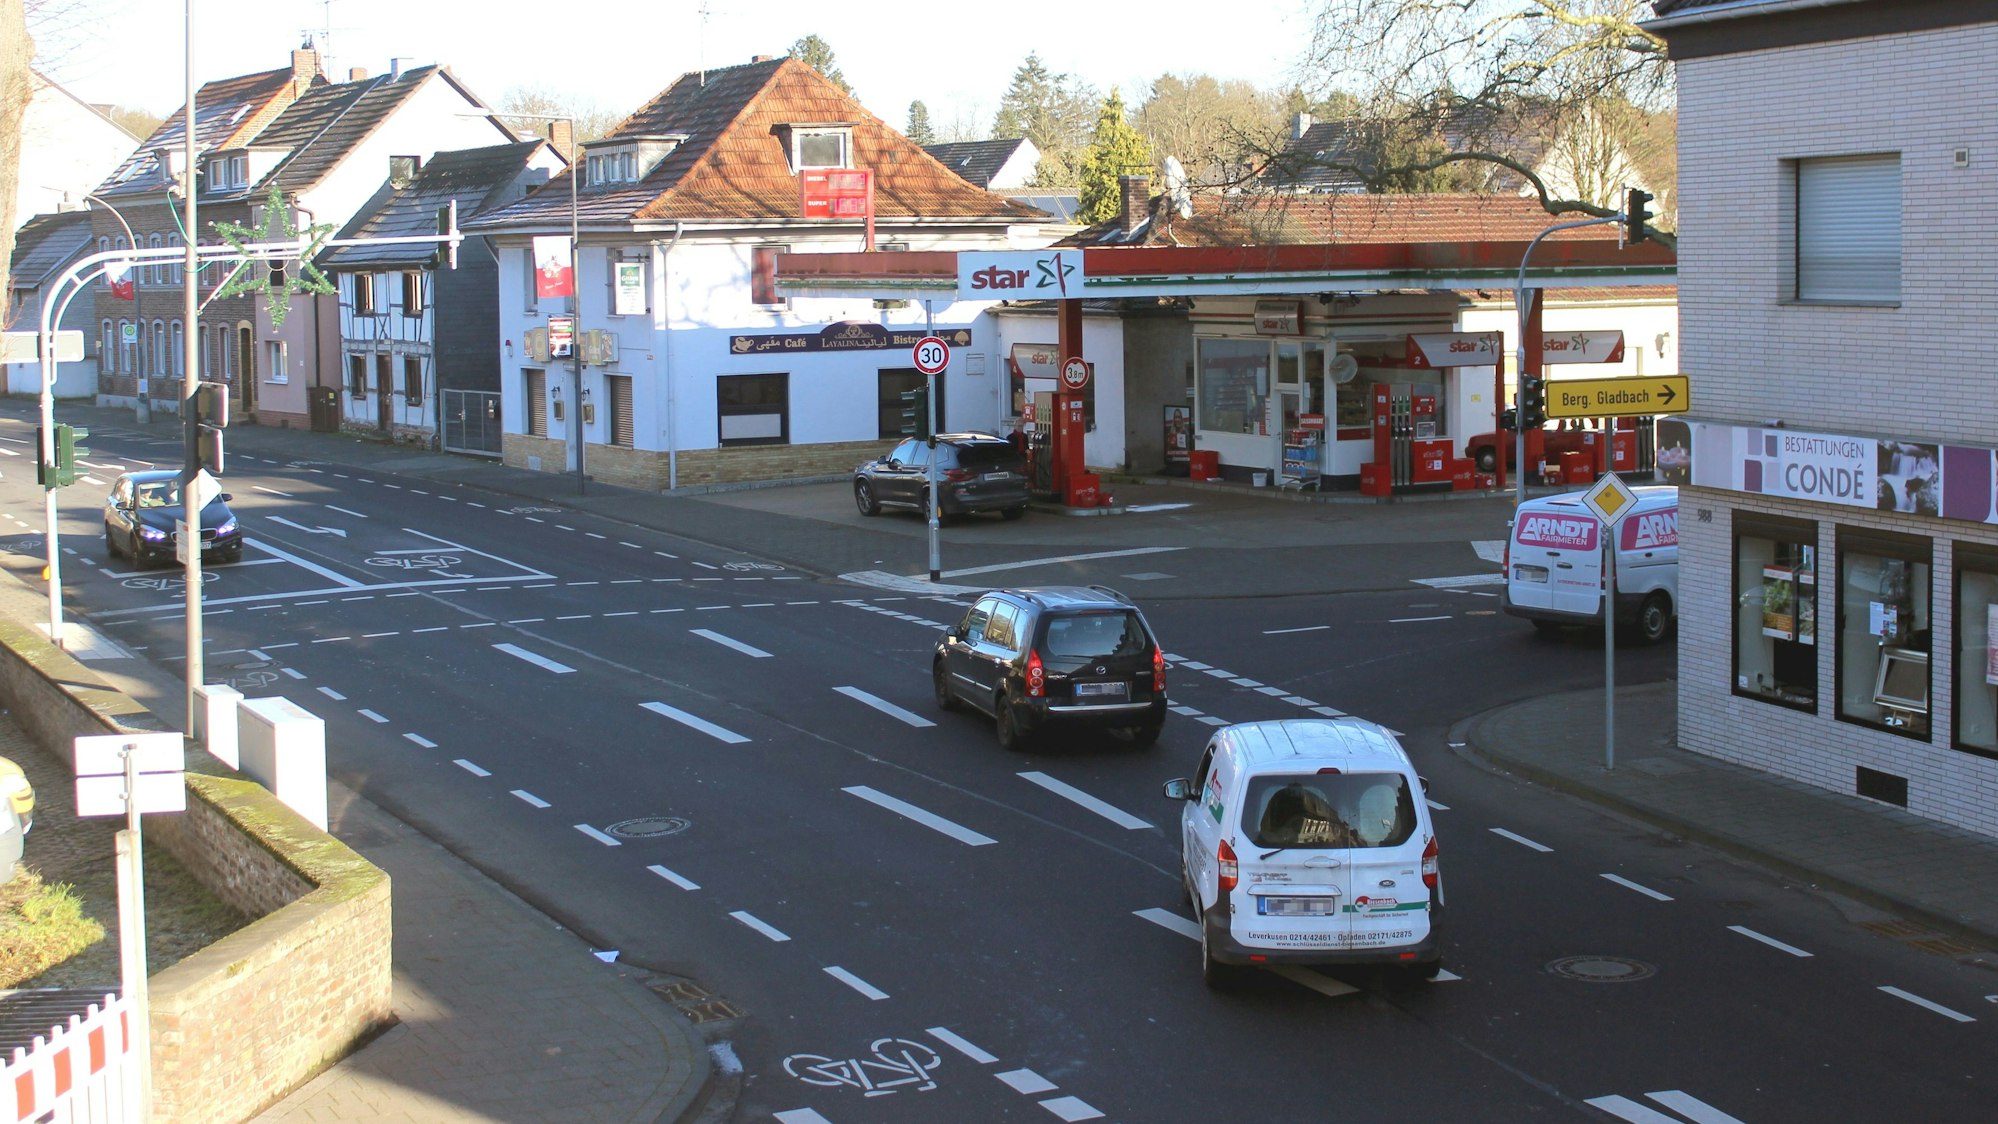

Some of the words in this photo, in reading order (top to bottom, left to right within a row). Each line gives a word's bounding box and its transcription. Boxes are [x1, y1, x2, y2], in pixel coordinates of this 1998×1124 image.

[971, 264, 1030, 289] star
[1262, 319, 1279, 329] star
[785, 337, 807, 348] Café
[1449, 340, 1477, 353] star
[1543, 338, 1570, 351] star
[921, 347, 942, 364] 30
[1031, 353, 1049, 364] star
[1414, 355, 1421, 365] 2
[1617, 350, 1622, 360] 1
[1562, 392, 1592, 409] Berg.
[1597, 390, 1649, 405] Gladbach
[1785, 436, 1865, 459] BESTATTUNGEN
[1785, 464, 1865, 500] CONDÉ
[1697, 508, 1712, 523] 988
[1519, 517, 1594, 541] ARNDT
[1540, 535, 1587, 546] FAIRMIETEN
[1248, 932, 1291, 942] Leverkusen
[1289, 934, 1331, 942] 0214/42461
[1337, 933, 1367, 943] Opladen
[1367, 930, 1413, 941] 02171/42875
